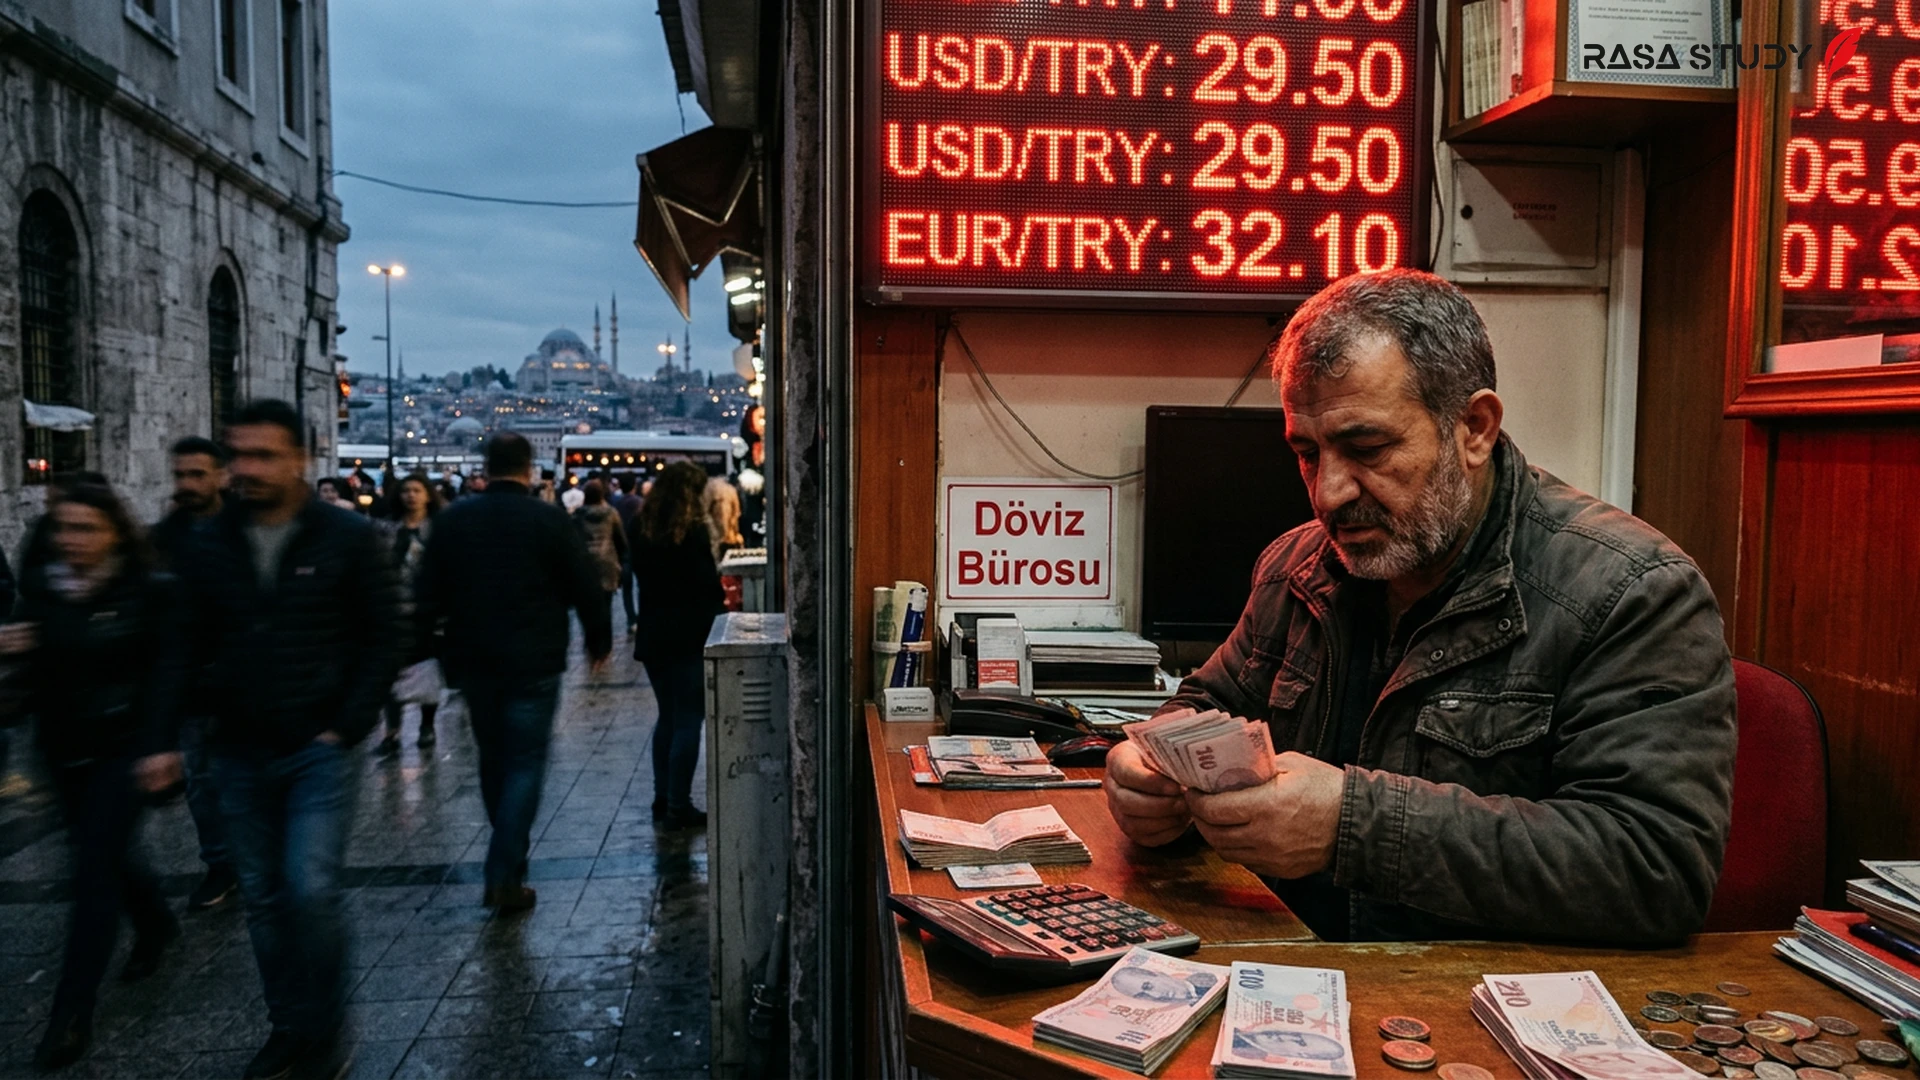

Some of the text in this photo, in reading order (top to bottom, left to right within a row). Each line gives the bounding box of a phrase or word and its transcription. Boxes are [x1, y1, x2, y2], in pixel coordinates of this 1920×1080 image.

[888, 33, 1404, 108] USD/TRY: 29.50
[887, 120, 1402, 194] USD/TRY: 29.50
[886, 209, 1399, 278] EUR/TRY: 32.10
[974, 500, 1085, 537] Döviz
[957, 549, 1100, 586] Bürosu
